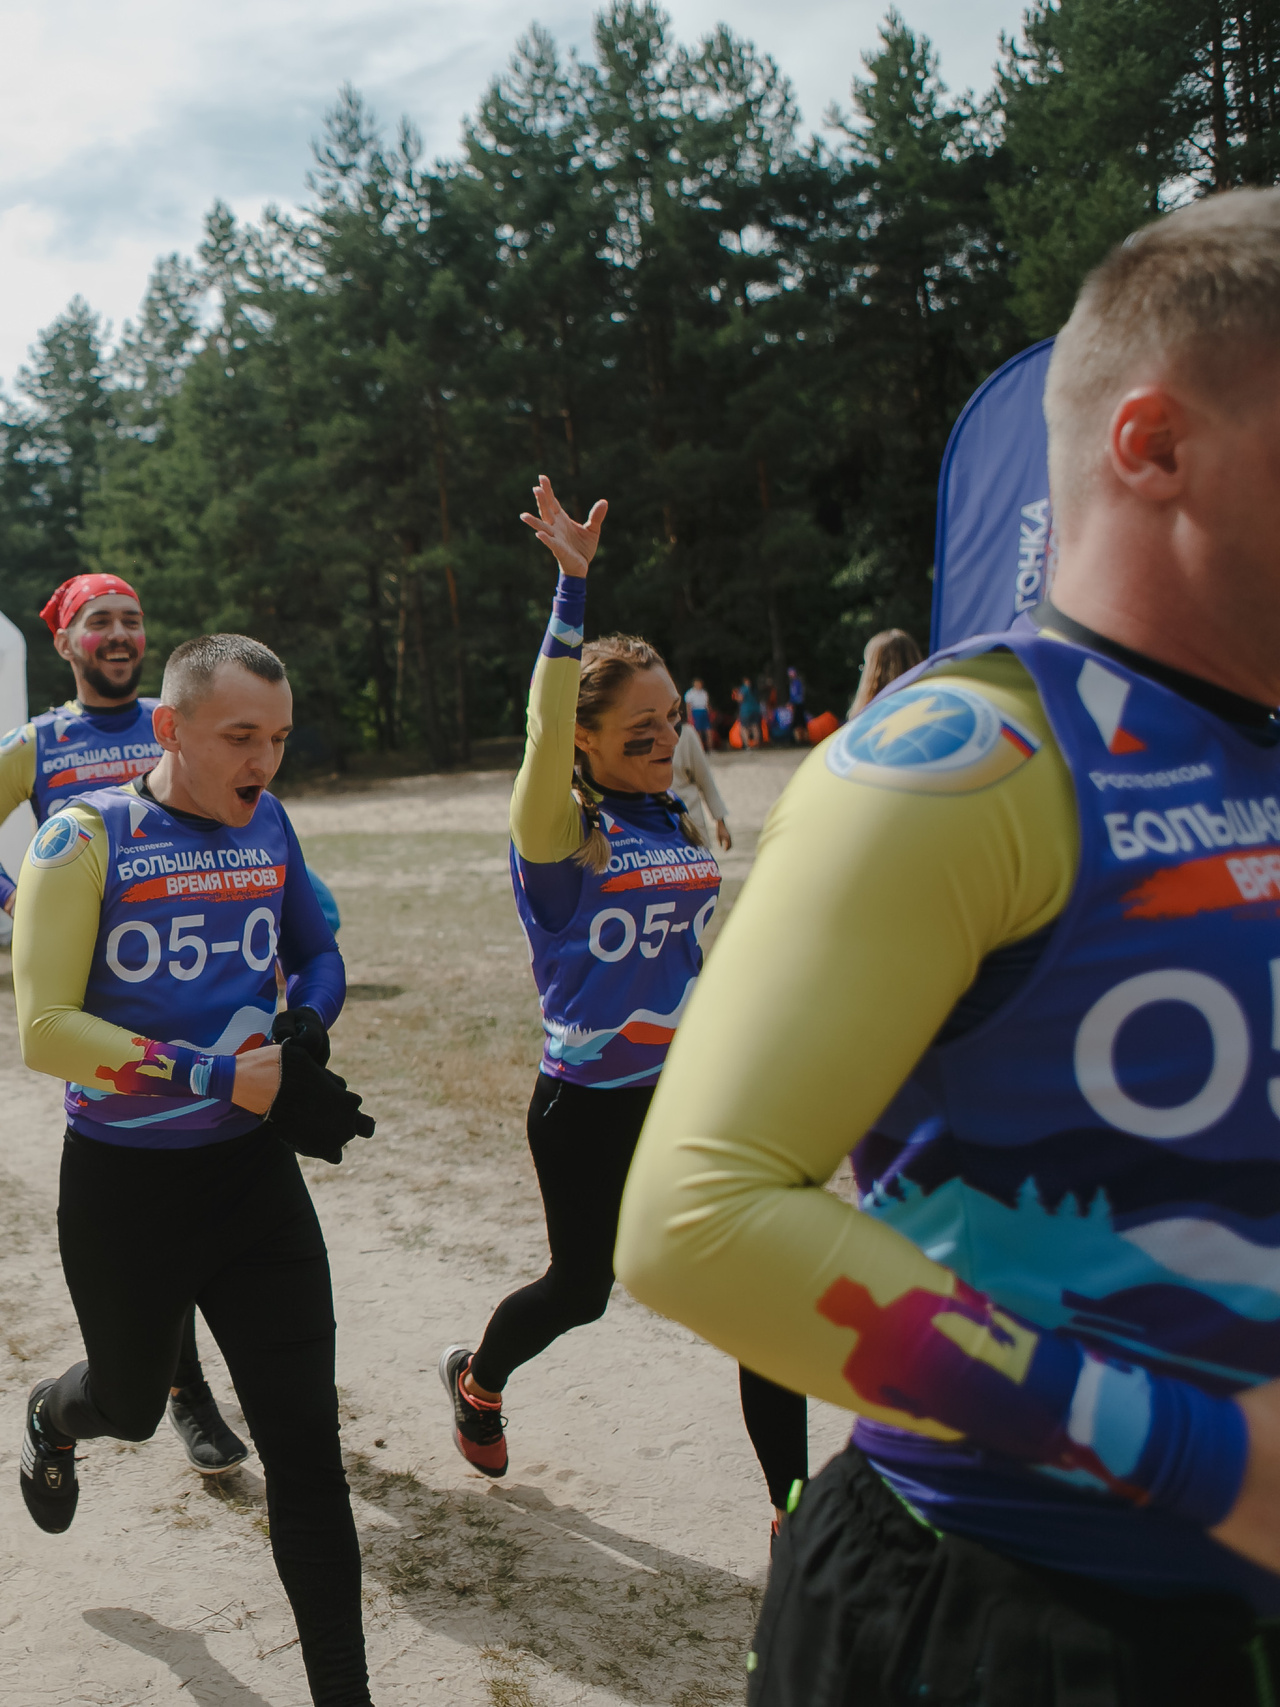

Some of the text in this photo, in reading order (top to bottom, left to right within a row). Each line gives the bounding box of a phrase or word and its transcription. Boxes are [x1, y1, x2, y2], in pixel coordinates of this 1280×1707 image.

[1015, 498, 1049, 614] ГОНКА
[42, 742, 165, 774] БОЛЬШАЯ ГОНК
[119, 841, 174, 855] Ростелеком
[600, 848, 680, 874] ОЛЬШАЯ
[117, 848, 274, 881] БОЛЬШАЯ ГОНКА
[641, 865, 690, 886] ВРЕМЯ
[166, 868, 278, 896] ВРЕМЯ ГЕРОЕВ
[106, 906, 278, 983] 05-0
[1073, 957, 1280, 1140] 0
